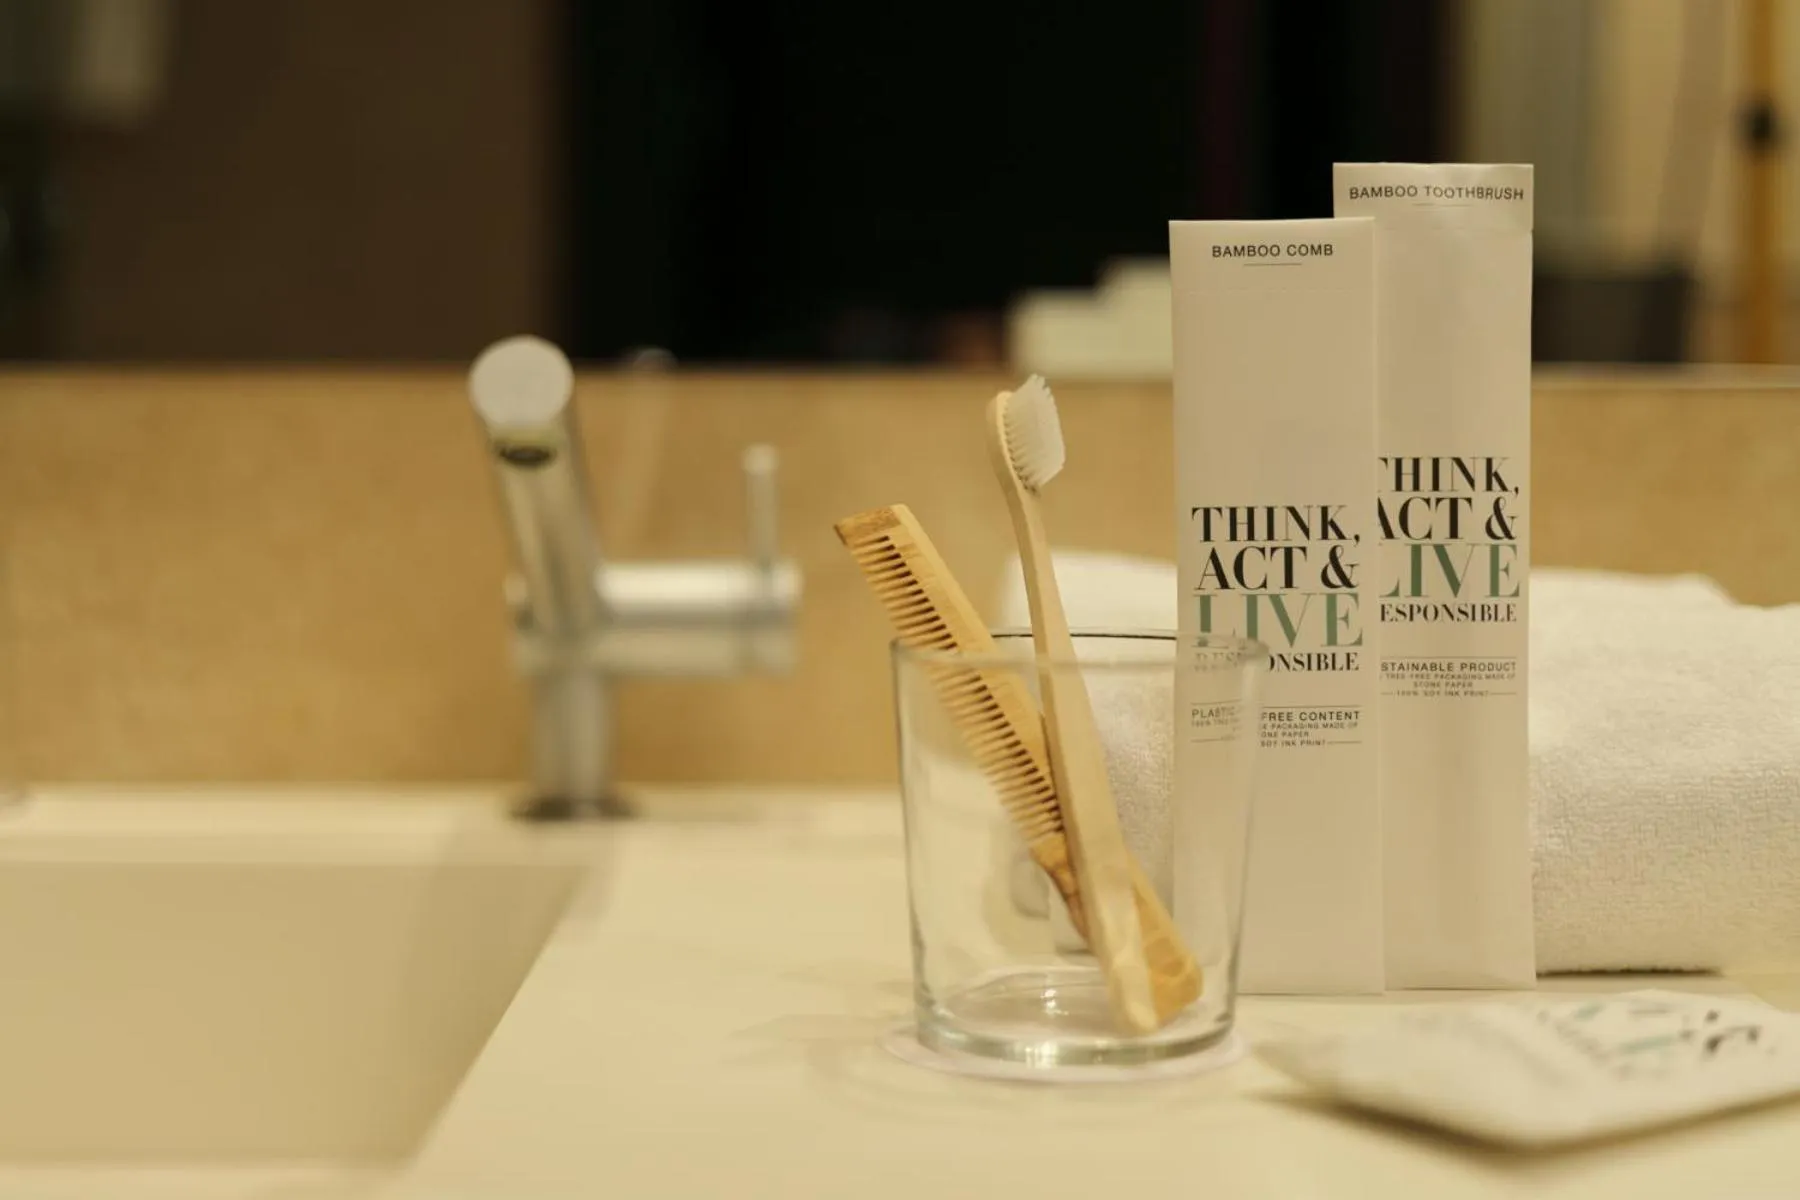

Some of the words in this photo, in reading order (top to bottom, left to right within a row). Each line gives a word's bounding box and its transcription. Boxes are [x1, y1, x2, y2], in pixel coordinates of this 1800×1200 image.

[1349, 185, 1418, 200] BAMBOO
[1425, 185, 1524, 200] TOOTHBRUSH
[1212, 245, 1281, 258] BAMBOO
[1287, 244, 1333, 257] COMB
[1485, 495, 1518, 540] &
[1192, 505, 1360, 548] THINK,
[1195, 545, 1308, 590] ACT
[1321, 544, 1360, 590] &
[1379, 603, 1517, 622] ESPONSIBLE
[1192, 592, 1363, 649] LIVE
[1380, 662, 1454, 672] STAINABLE
[1460, 661, 1516, 672] PRODUCT
[1299, 711, 1360, 722] CONTENT
[1261, 731, 1278, 739] ONE
[1281, 731, 1309, 739] PAPER
[1281, 739, 1297, 747] INK
